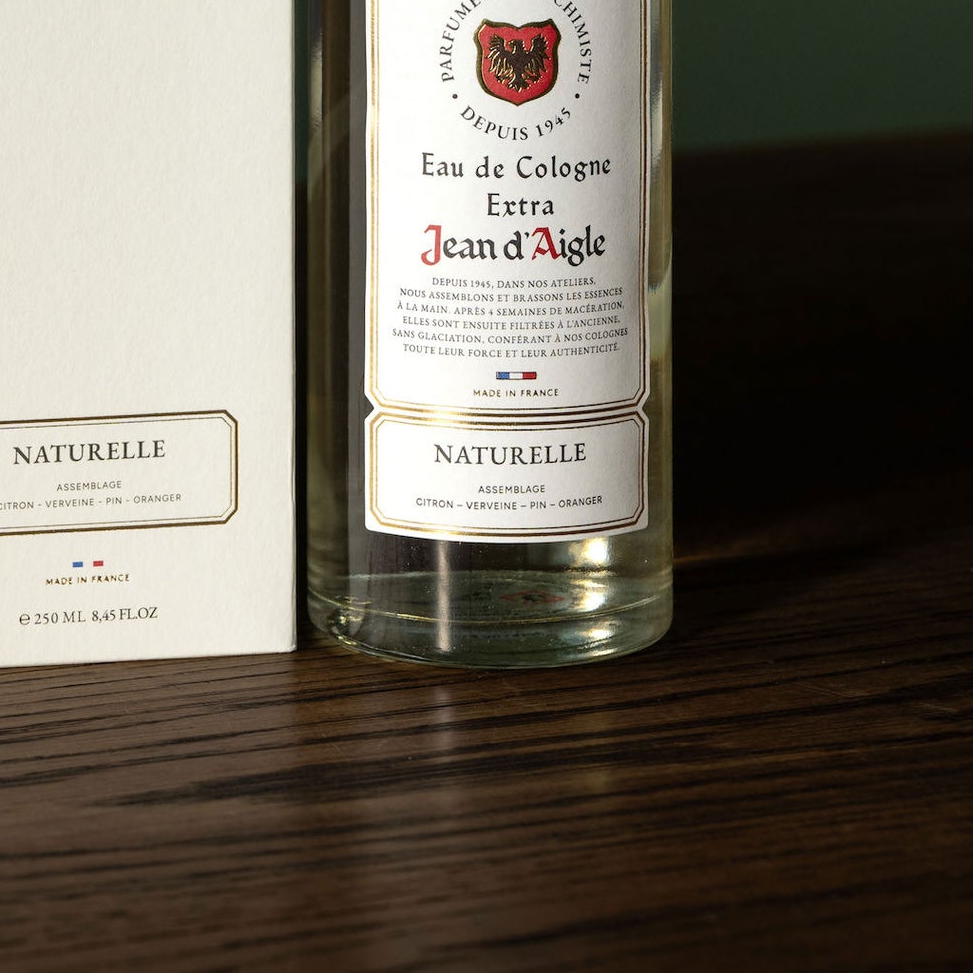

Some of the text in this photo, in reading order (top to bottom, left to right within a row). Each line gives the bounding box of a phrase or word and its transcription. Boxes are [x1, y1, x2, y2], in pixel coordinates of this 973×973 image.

[461, 106, 570, 140] DEPUIS 1945
[422, 152, 610, 182] Eau de Cologne
[487, 193, 554, 217] Extra
[421, 225, 605, 267] Jean d'Aigle
[432, 277, 596, 289] DEPUIS 1945, DANS NOS ATELIERS,
[400, 287, 622, 302] NOUS ASSEMBLONS ET BRASSONS LES ESSENCES
[397, 300, 624, 316] À LA MAIN. APRÈS 4 SEMAINES DE MACÉRATION,
[403, 316, 620, 331] ELLES SONT ENSUITE FILTRÉES À L'ANCIENNE,
[393, 327, 628, 344] SANS GLACIATION, CONFÉRANT À NOS COLOGNES
[403, 342, 620, 358] TOUTE LEUR FORCE ET LEUR AUTHENTICITÉ.
[521, 389, 558, 397] FRANCE
[13, 440, 165, 464] NATURELLE
[434, 443, 586, 465] NATURELLE
[57, 481, 121, 491] ASSEMBLAGE
[478, 485, 545, 494] ASSEMBLAGE
[45, 498, 94, 508] VERVEINE
[106, 497, 122, 505] PIN
[133, 494, 181, 504] ORANGER
[416, 498, 453, 508] CITRON
[466, 502, 517, 510] VERVEINE
[530, 501, 546, 509] PIN
[558, 495, 602, 508] ORANGER
[46, 577, 72, 585] MADE
[92, 574, 129, 582] FRANCE
[35, 612, 58, 624] 250
[63, 611, 86, 623] ML
[92, 610, 115, 623] 8,45
